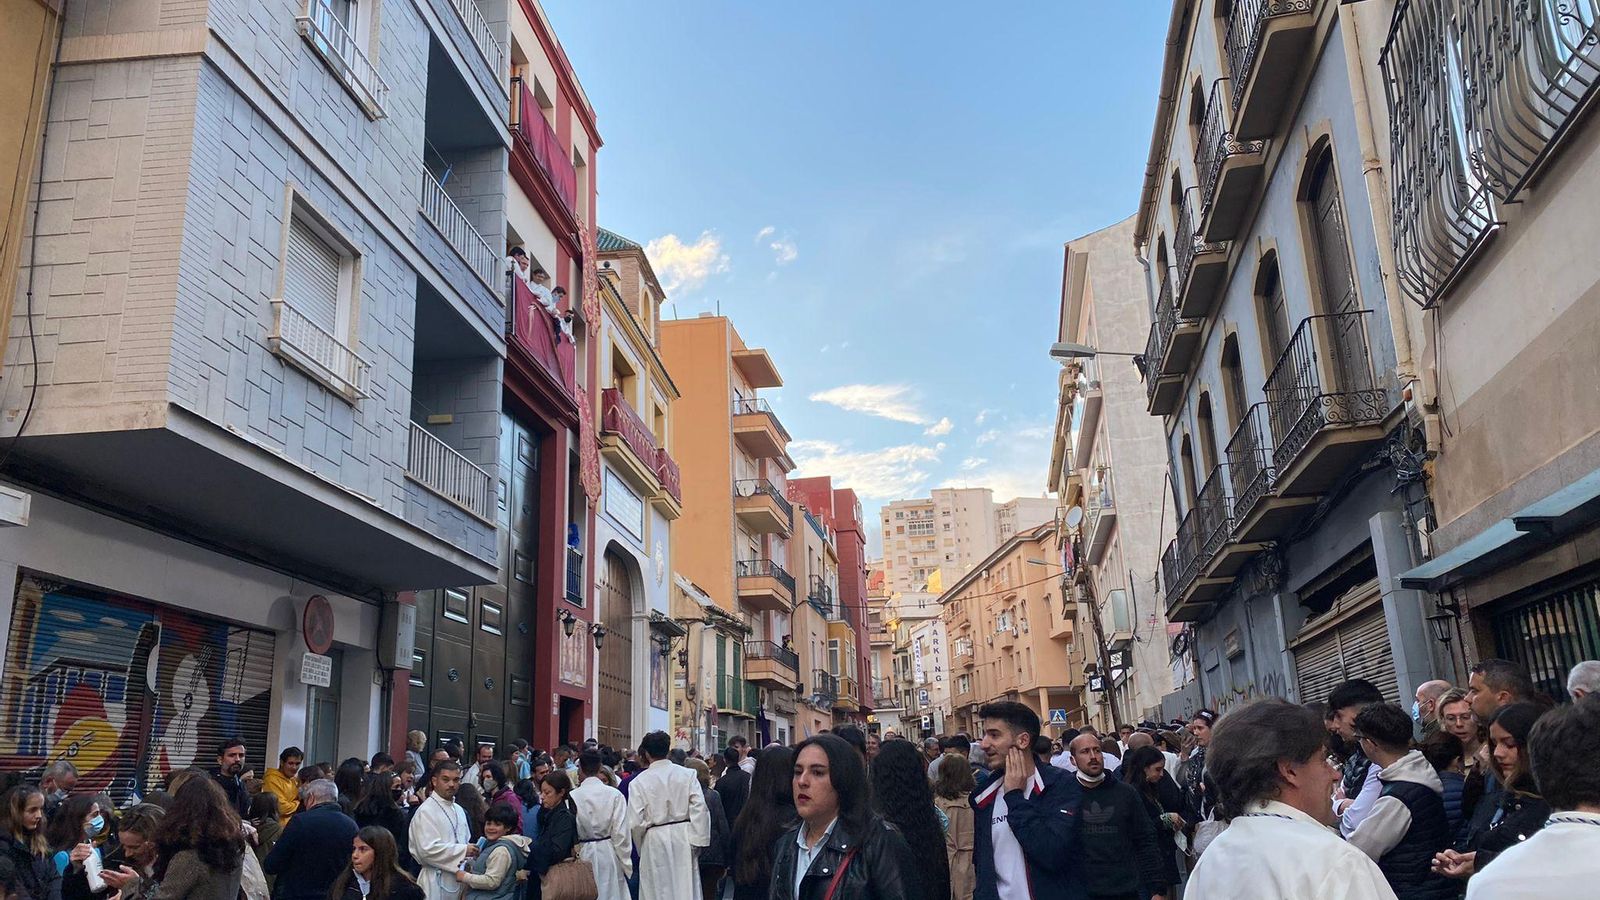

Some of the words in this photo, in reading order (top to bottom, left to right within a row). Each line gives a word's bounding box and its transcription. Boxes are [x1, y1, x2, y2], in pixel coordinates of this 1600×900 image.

[914, 640, 922, 673] PARKING
[931, 620, 942, 682] PARKING
[920, 690, 928, 701] P
[922, 715, 930, 727] P
